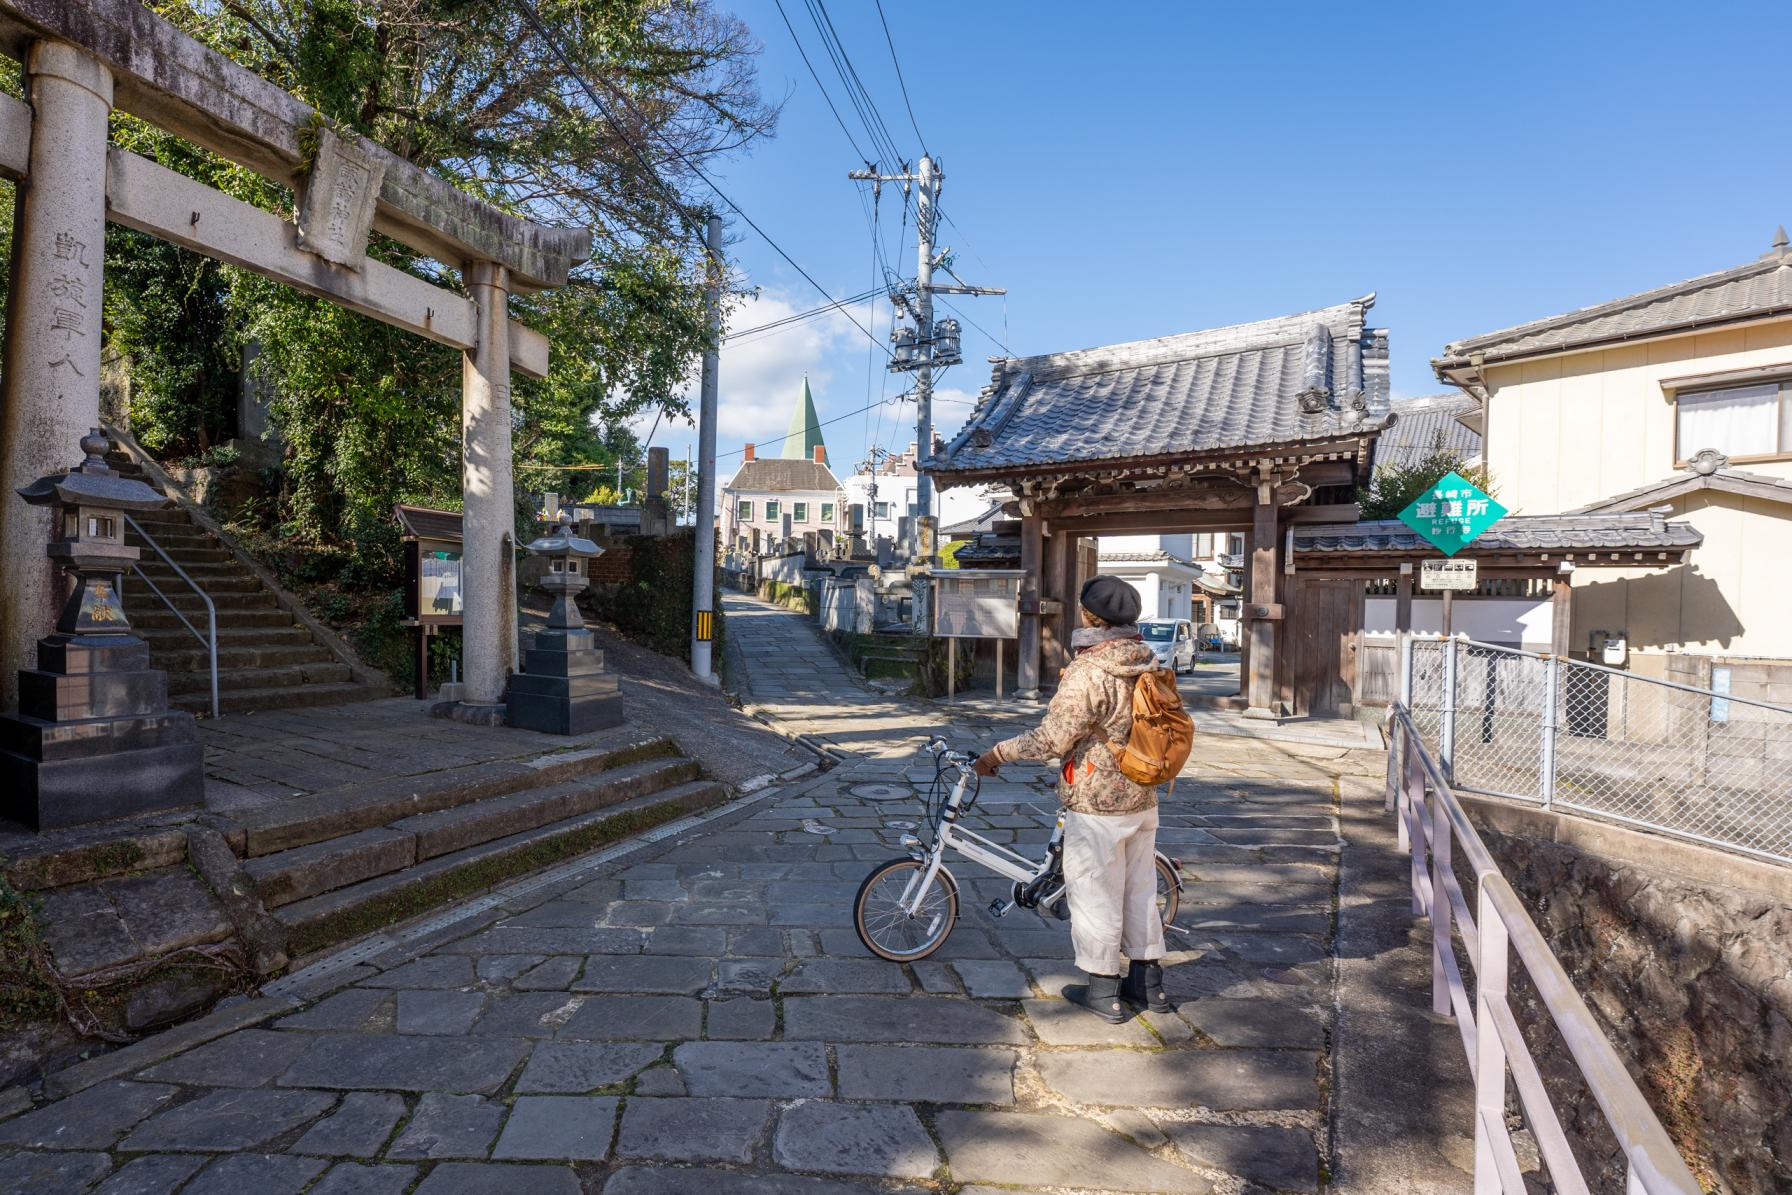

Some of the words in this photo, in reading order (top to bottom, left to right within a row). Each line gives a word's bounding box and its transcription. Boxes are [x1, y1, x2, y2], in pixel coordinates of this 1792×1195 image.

[1432, 489, 1473, 499] 長崎市
[1415, 499, 1489, 518] 避難所
[1431, 517, 1471, 525] REFUGE
